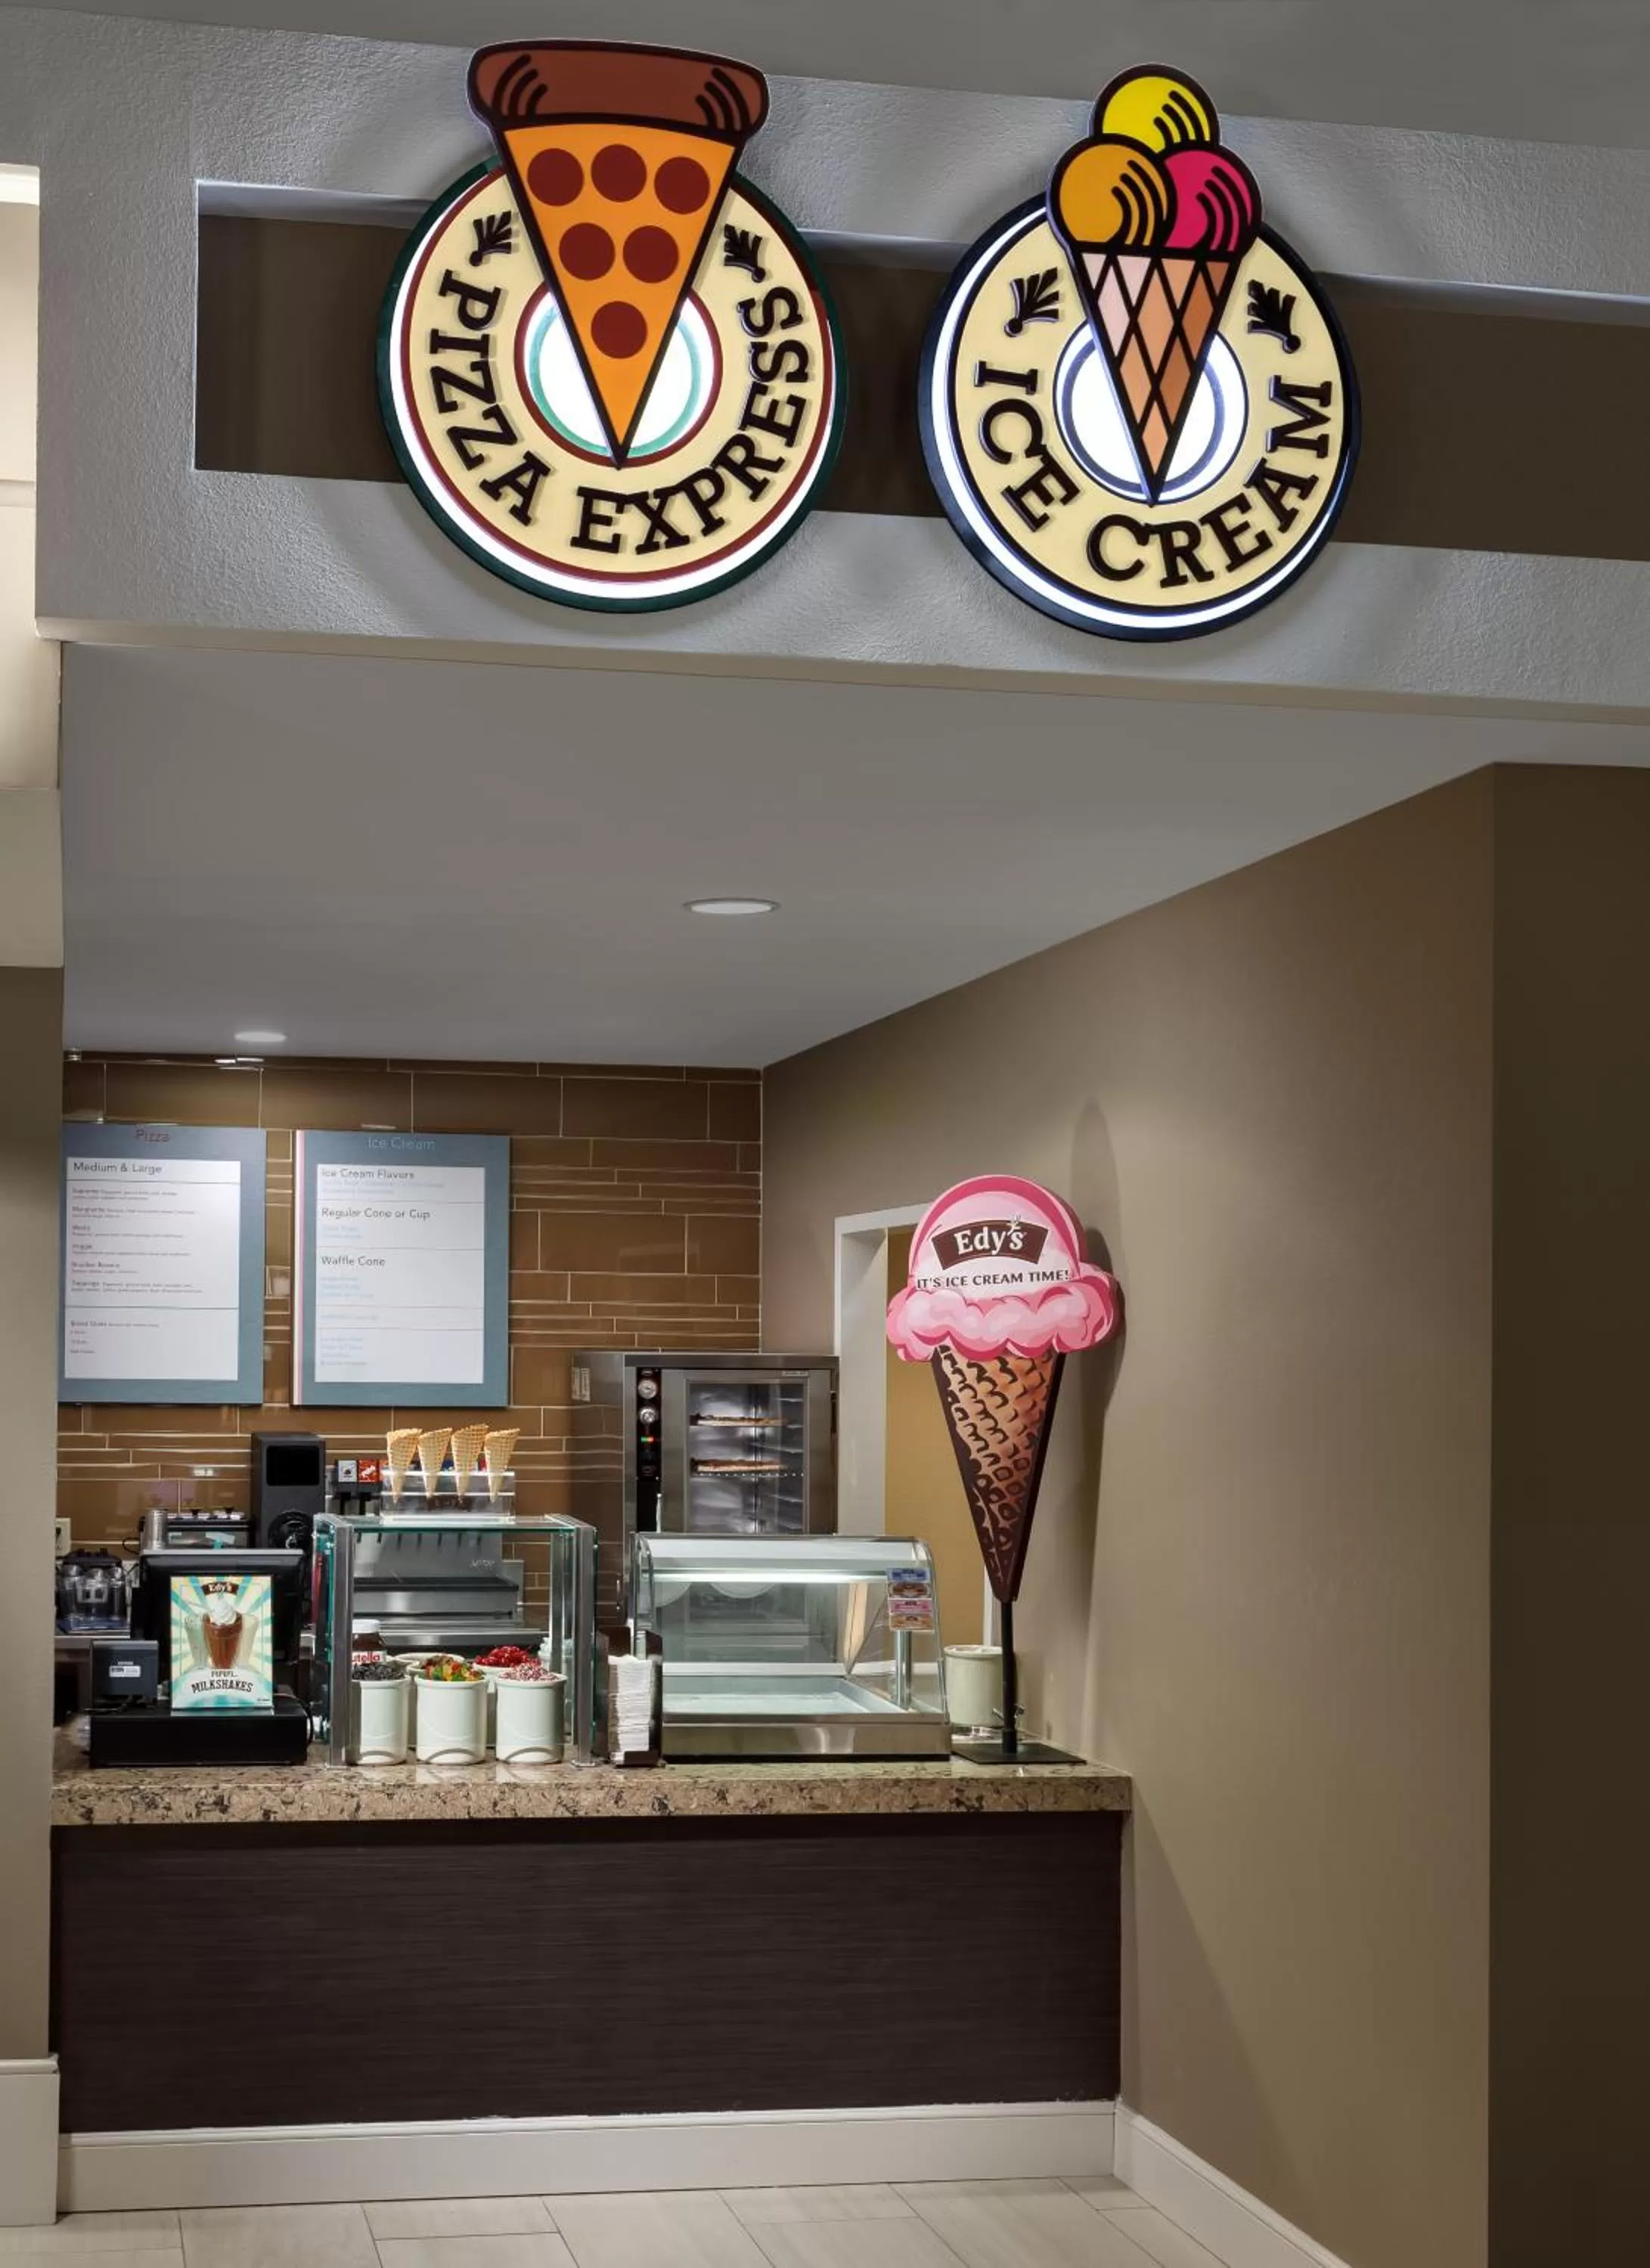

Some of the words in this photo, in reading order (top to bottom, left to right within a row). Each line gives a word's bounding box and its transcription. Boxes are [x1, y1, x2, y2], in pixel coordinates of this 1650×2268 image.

[430, 269, 552, 526] PIZZA
[570, 287, 809, 554] EXPRESS
[974, 361, 1081, 532] ICE
[1086, 375, 1332, 588] CREAM
[135, 1128, 170, 1143] Pizza
[368, 1136, 386, 1149] Ice
[390, 1137, 436, 1151] Cream
[73, 1162, 118, 1173] Medium
[120, 1163, 129, 1173] &
[132, 1163, 163, 1176] Large
[322, 1169, 336, 1178] Ice
[340, 1168, 374, 1179] Cream
[321, 1208, 361, 1219] Regular
[364, 1207, 392, 1219] Cone
[409, 1209, 431, 1222] Cup
[954, 1225, 1025, 1256] Edy's
[321, 1255, 355, 1266] Waffle
[358, 1256, 386, 1267] Cone
[916, 1278, 941, 1289] IT'S
[946, 1275, 969, 1287] ICE
[972, 1272, 1023, 1285] CREAM
[1028, 1269, 1069, 1282] TIME!
[191, 1678, 254, 1694] MILKSHAKES
